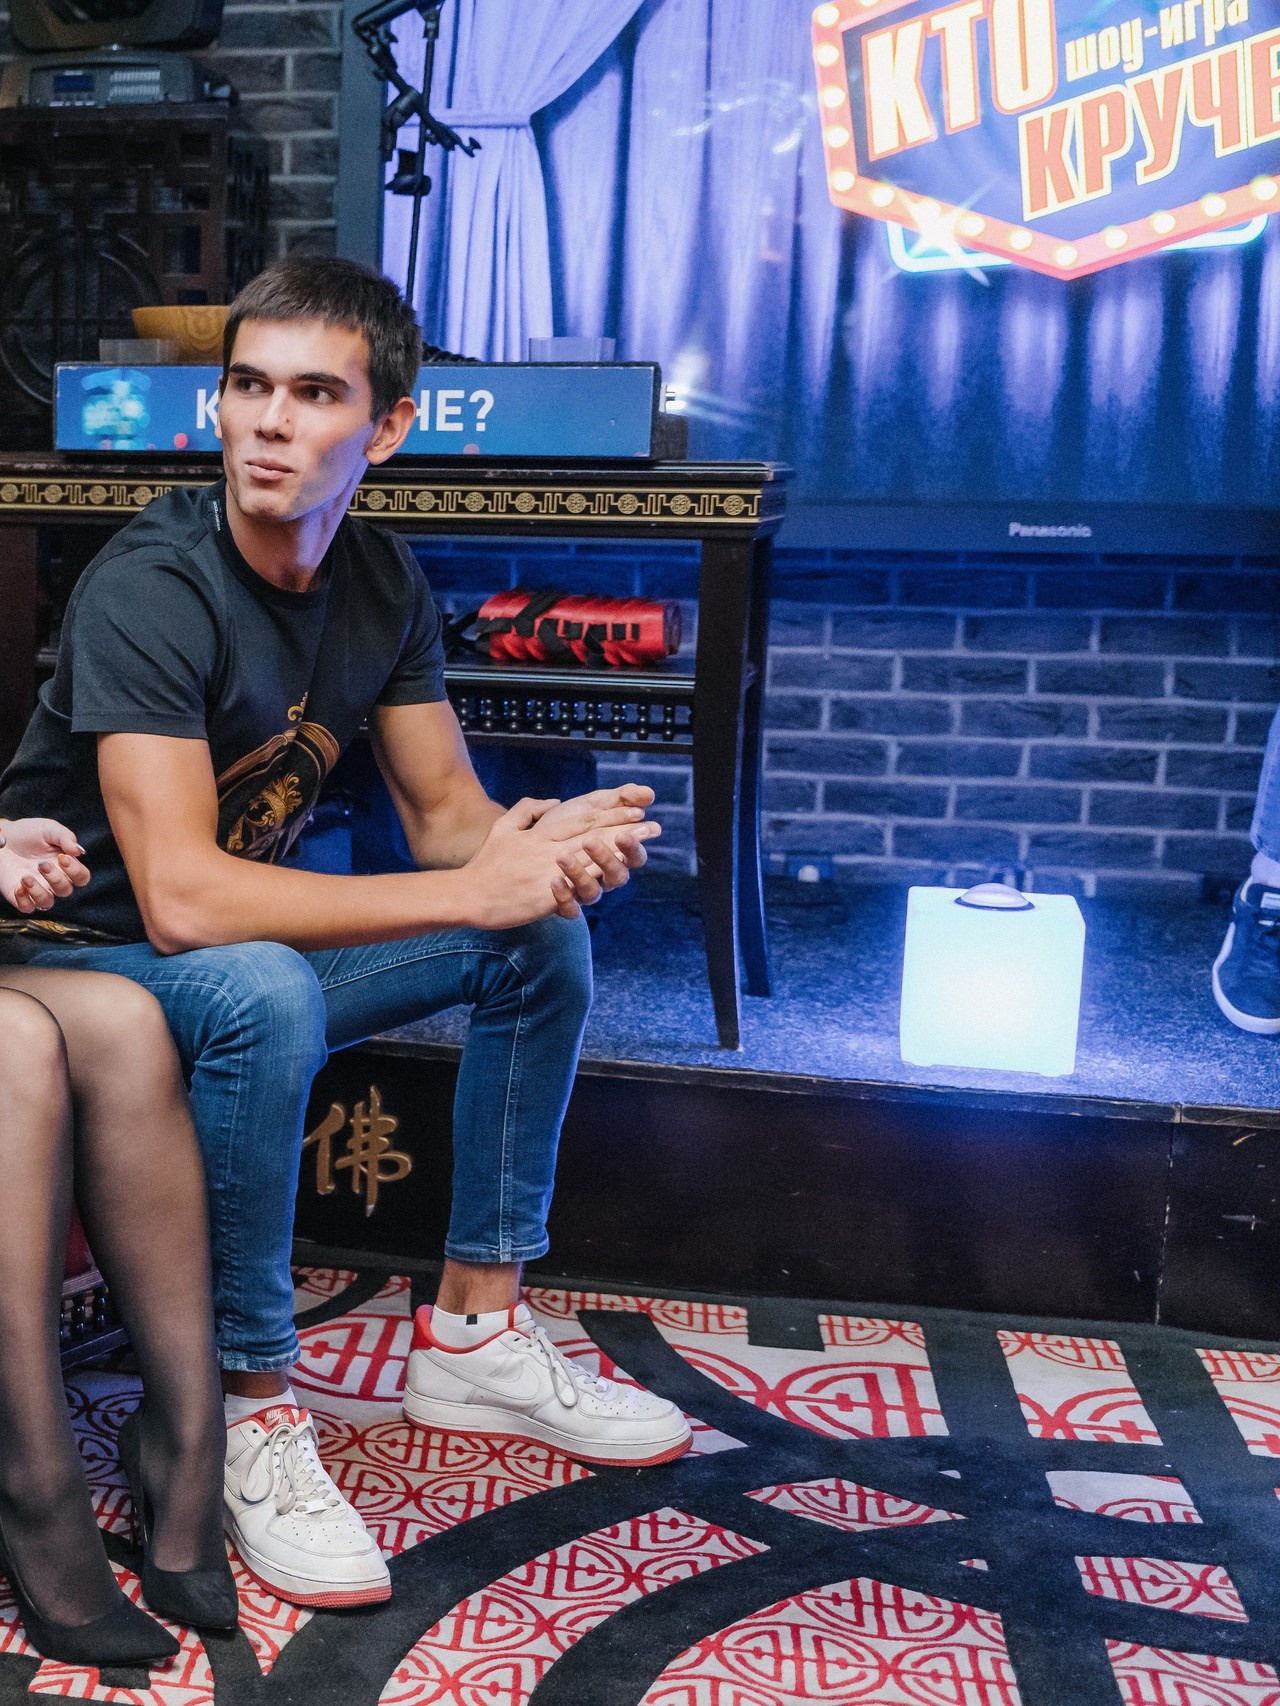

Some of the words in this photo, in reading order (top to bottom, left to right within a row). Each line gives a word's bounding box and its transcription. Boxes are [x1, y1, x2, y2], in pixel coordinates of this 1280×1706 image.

[862, 0, 1058, 160] КТО
[1064, 0, 1250, 83] шоу-игра
[1018, 27, 1280, 222] КРУЧЕ
[1008, 521, 1093, 538] Panasonic
